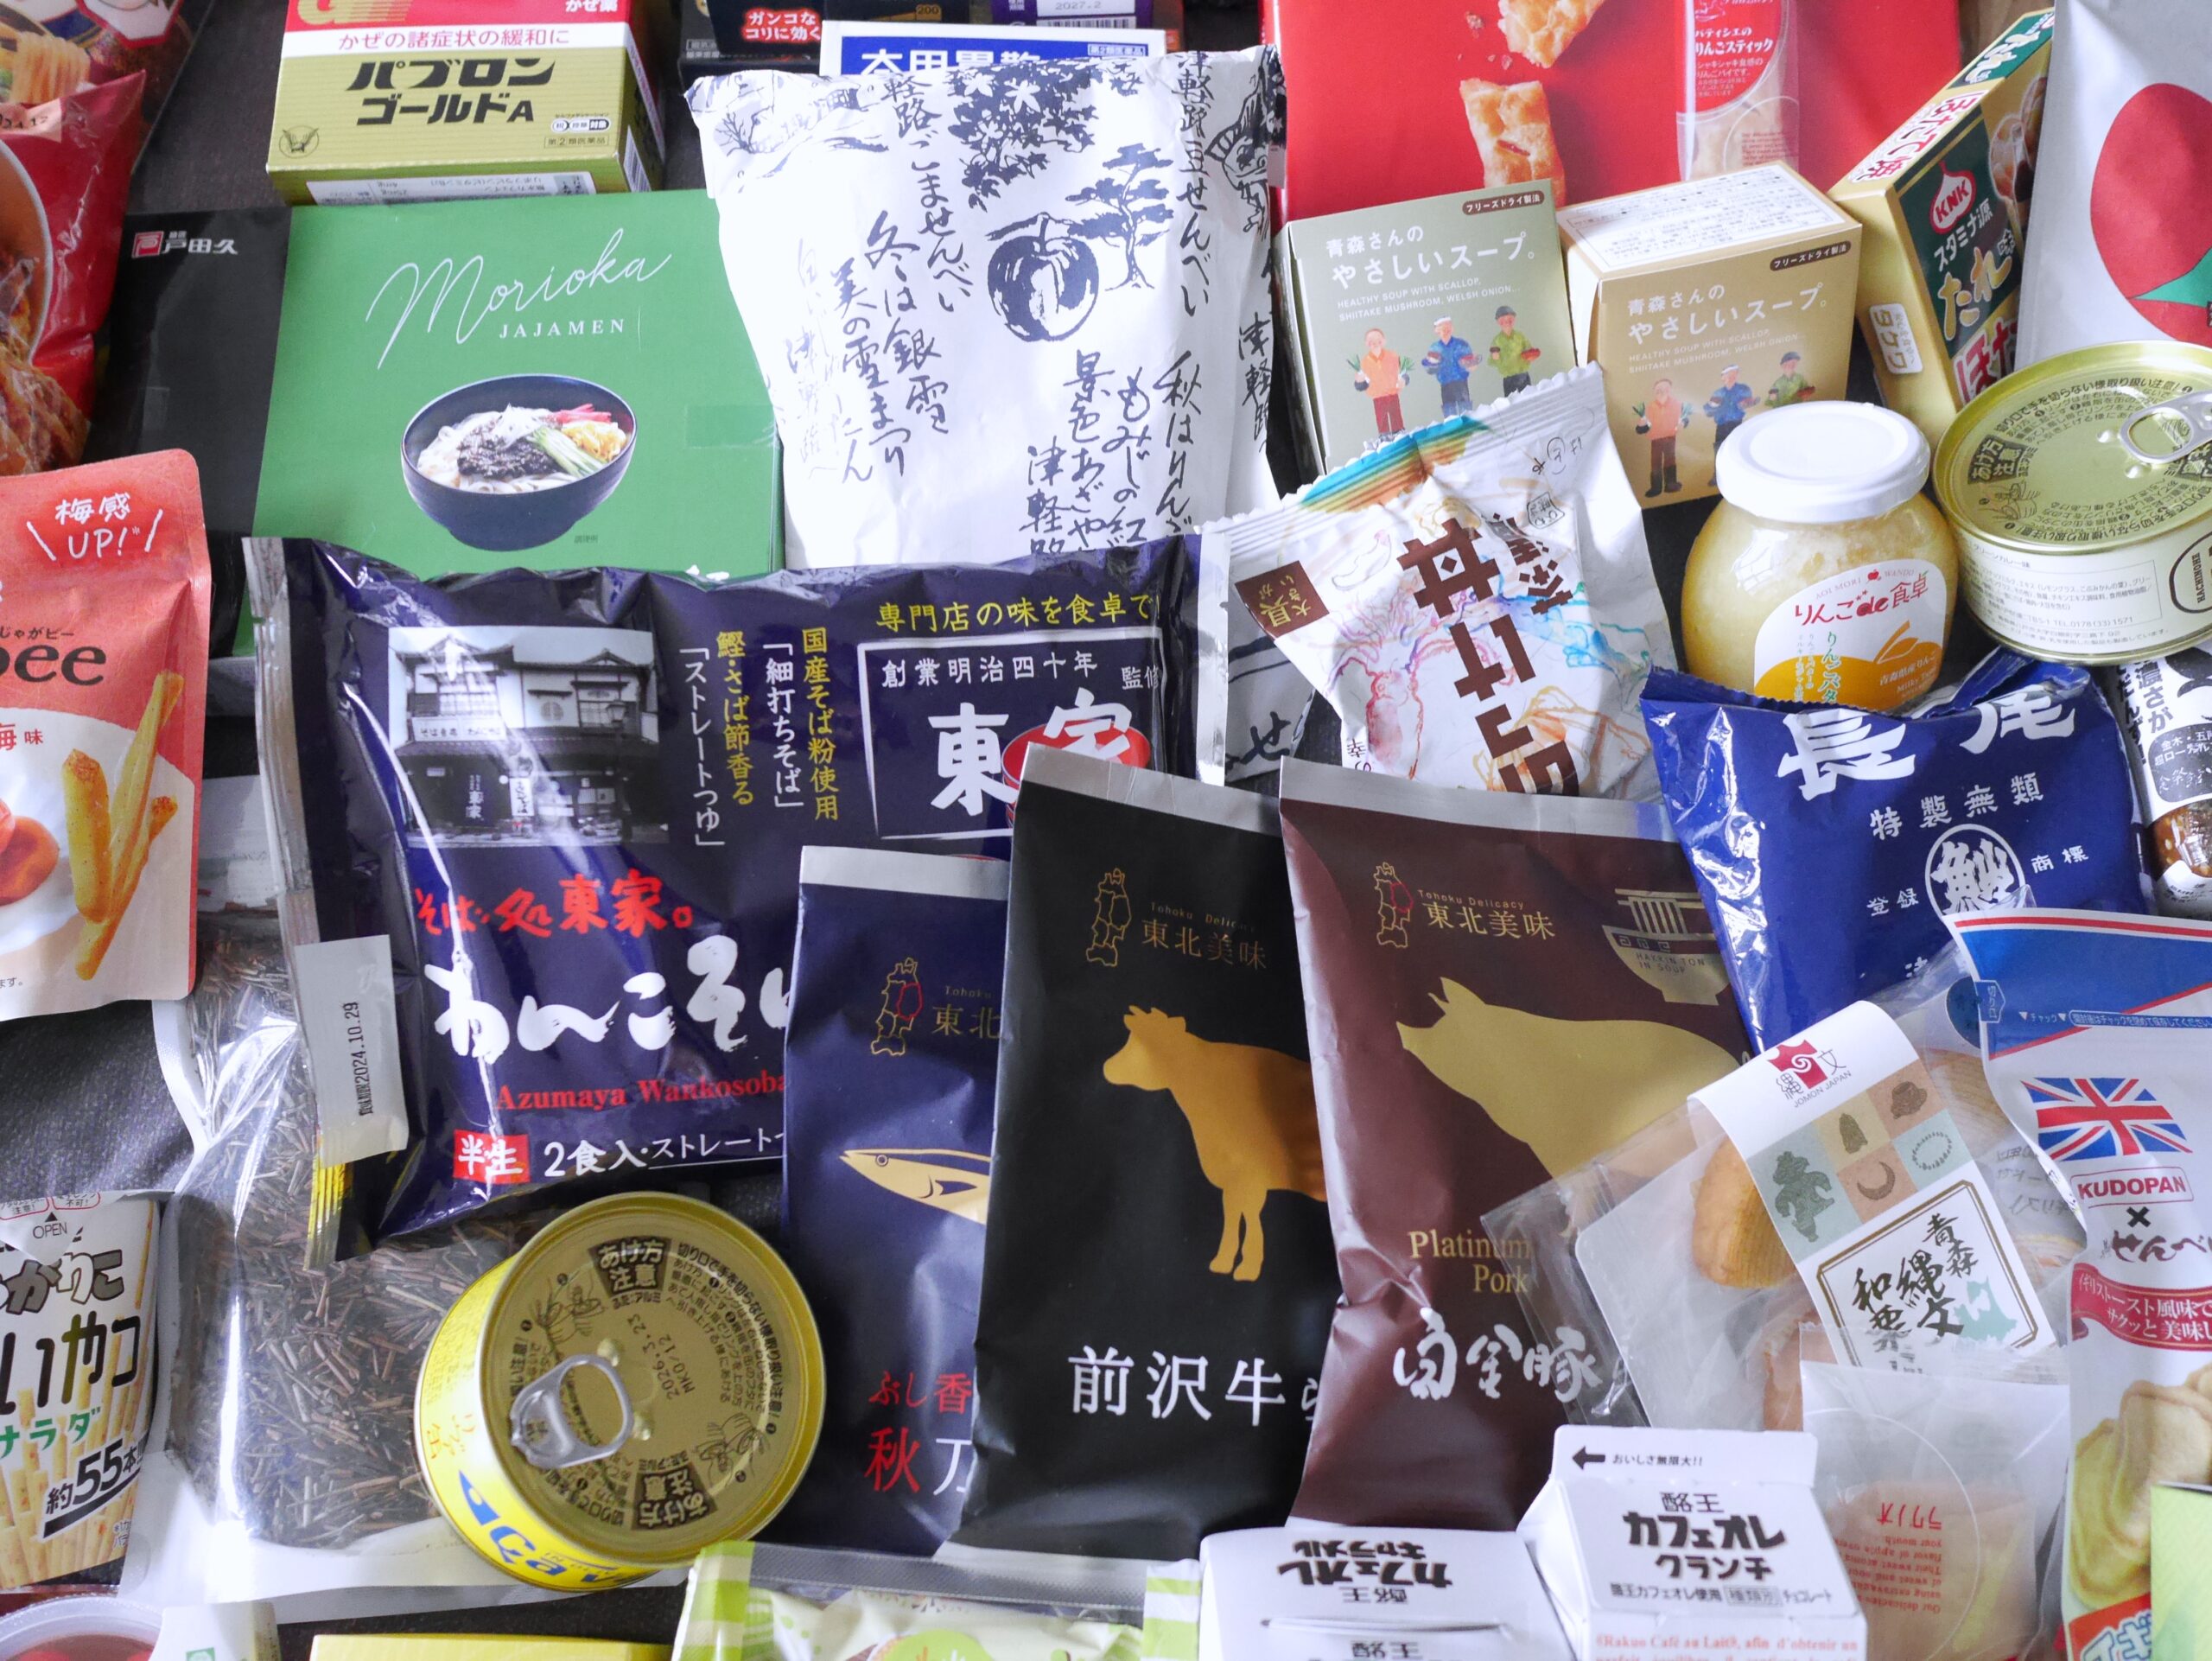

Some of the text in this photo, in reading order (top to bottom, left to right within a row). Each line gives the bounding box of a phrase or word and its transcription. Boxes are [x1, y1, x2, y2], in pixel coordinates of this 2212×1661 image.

[745, 26, 821, 41] コリに効く
[748, 10, 817, 26] ガンコな
[338, 28, 570, 50] かぜの諸症状の緩和に
[1695, 38, 1774, 56] りんごスティック
[346, 57, 556, 92] パブロン
[356, 92, 535, 125] ゴールドA
[1465, 194, 1541, 213] フリーズドライ製法
[1935, 180, 1970, 223] KNK
[1325, 226, 1425, 258] 青森さんの
[1934, 197, 1994, 273] スタミナ源
[1331, 233, 1535, 291] やさしいスープ。
[1772, 243, 1848, 270] フリーズドライ製法
[365, 227, 672, 370] Morioka
[1338, 292, 1381, 309] HEALTHY
[1382, 288, 1409, 302] SOUP
[1411, 283, 1434, 297] WITH
[1338, 307, 1382, 322] SHIITAKE
[1446, 292, 1479, 306] WELSH
[1627, 283, 1726, 315] 青森さんの
[498, 318, 626, 340] JAJAMEN
[1629, 283, 1827, 345] やさしいスープ。
[1629, 347, 1672, 363] HEALTHY
[1673, 343, 1700, 356] SOUP
[1702, 338, 1726, 351] WITH
[1629, 360, 1672, 375] SHIITAKE
[54, 491, 131, 525] 梅感
[2191, 552, 2206, 604] HACHINOHE
[880, 649, 1099, 690] 創業明治四十年
[802, 627, 840, 822] 国産そば粉使用
[1150, 901, 1193, 920] Tohoku
[1417, 888, 1525, 912] Tohoku Delicacy
[1421, 901, 1556, 941] 東北美味
[1141, 919, 1267, 971] 東北美味
[944, 984, 993, 1000] Tohoku
[495, 1081, 626, 1112] Azumaya
[1793, 1069, 1853, 1109] JOMON JAPAN
[455, 1136, 524, 1179] 半生
[2077, 1175, 2188, 1201] KUDOPAN
[32, 1222, 68, 1239] OPEN
[1409, 1230, 1532, 1262] Platinum
[597, 1241, 664, 1267] あけ方
[0, 1249, 125, 1316] がりこ
[1472, 1263, 1529, 1295] Pork
[1660, 1491, 1726, 1514] 酪王
[1622, 1510, 1786, 1551] カフェオレ
[1293, 1539, 1427, 1560] キャラメル
[1278, 1561, 1453, 1590] カフェオレ
[1654, 1554, 1773, 1581] クランチ
